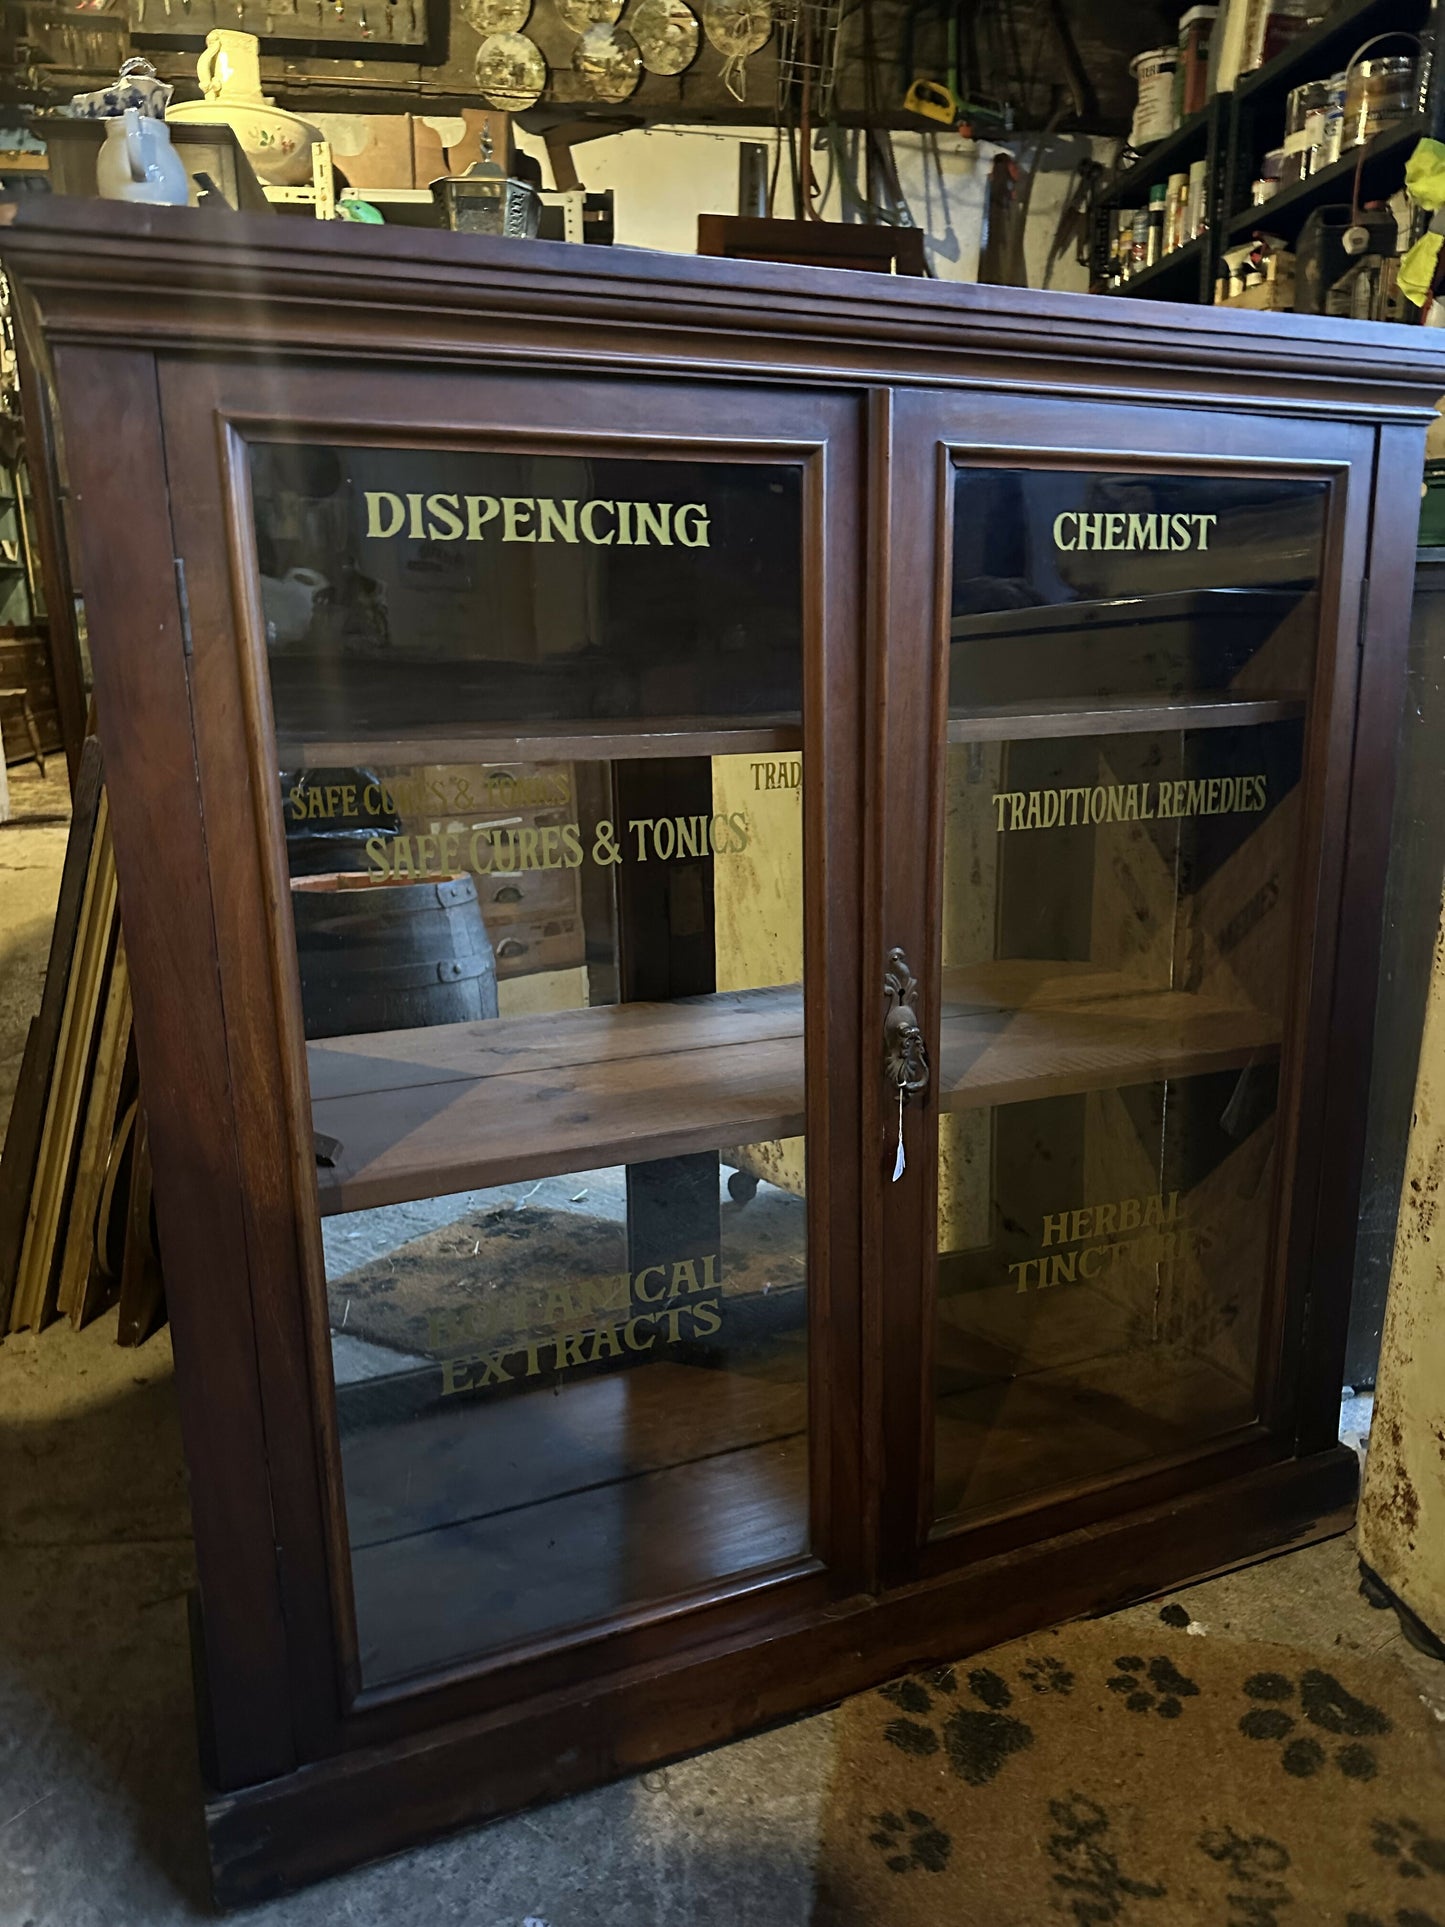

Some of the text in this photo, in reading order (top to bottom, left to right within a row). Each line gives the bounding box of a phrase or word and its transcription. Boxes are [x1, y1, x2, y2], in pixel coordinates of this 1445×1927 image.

[364, 491, 711, 547] DISPENCING
[1053, 511, 1218, 552] CHEMIST
[289, 783, 358, 821] SAFE
[454, 776, 475, 810] &
[992, 775, 1268, 832] TRADITIONAL REMEDIES
[367, 811, 749, 883] SAFE CURES & TONICS
[1041, 1190, 1186, 1248] HERBAL
[440, 1298, 723, 1397] EXTRACTS
